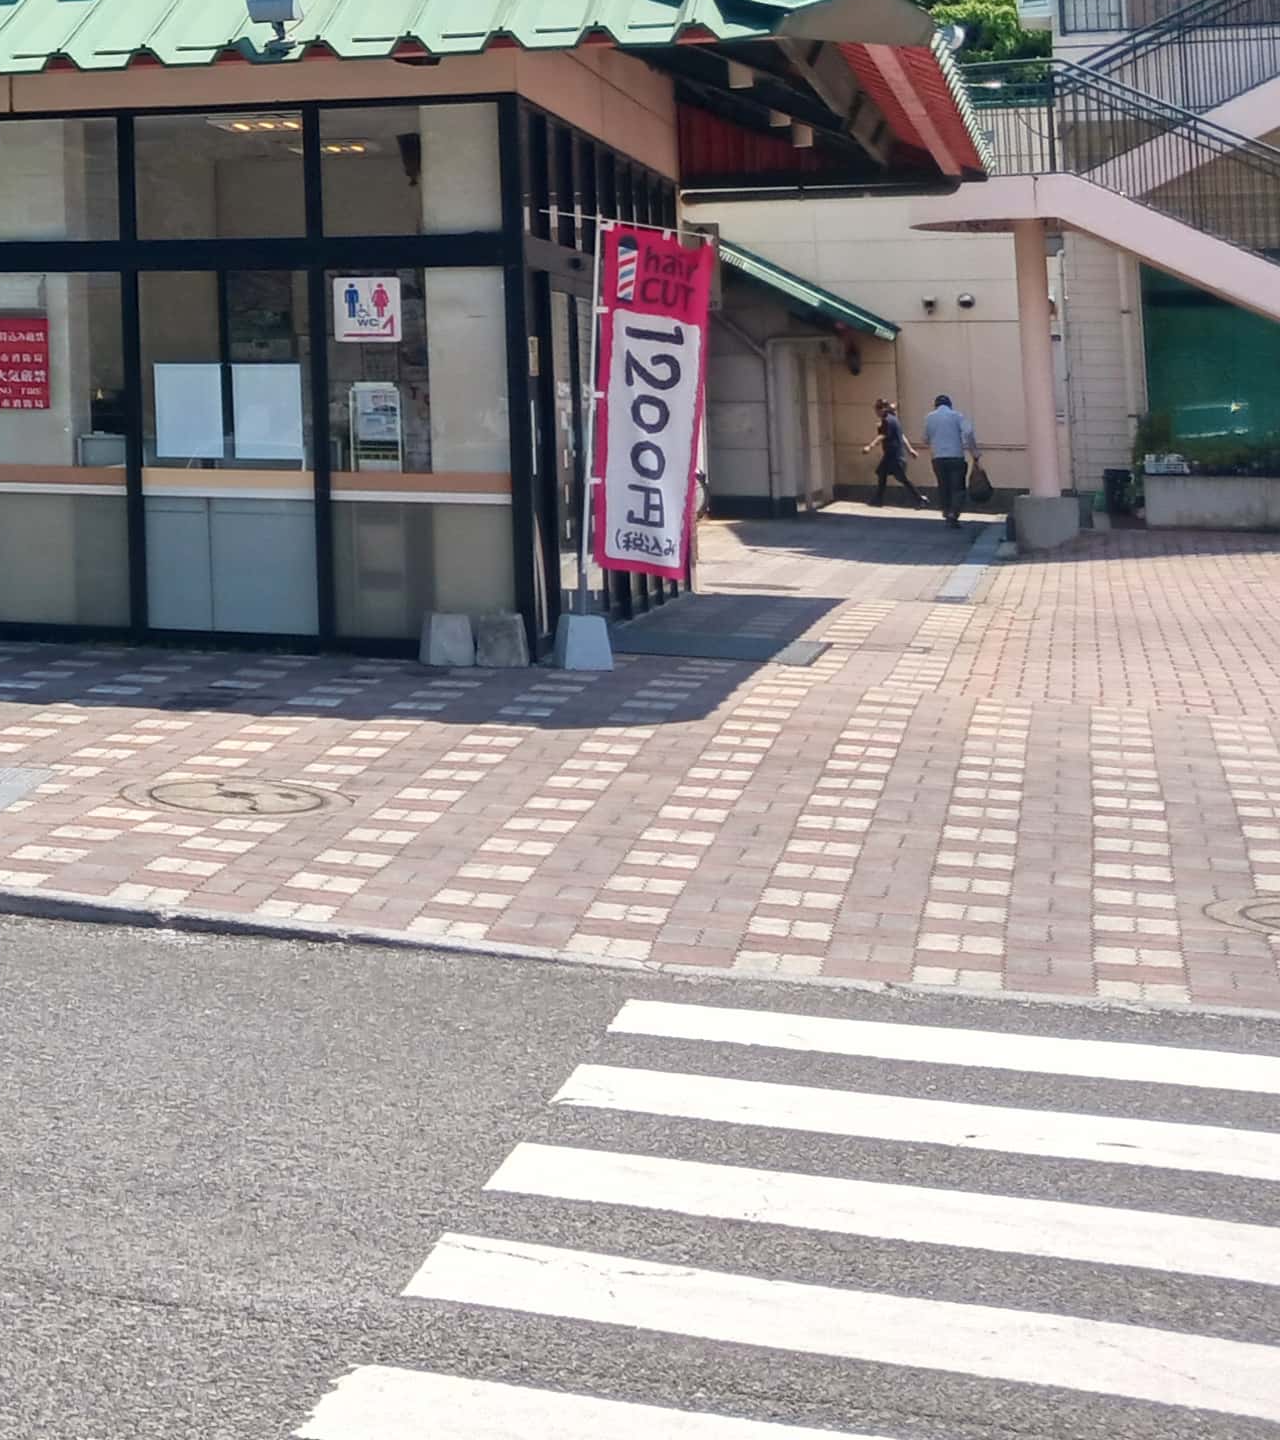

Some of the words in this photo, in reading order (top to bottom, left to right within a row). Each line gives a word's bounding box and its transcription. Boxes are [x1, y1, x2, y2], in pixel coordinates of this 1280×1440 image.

[643, 246, 699, 279] hair
[641, 277, 696, 311] CUT
[357, 318, 380, 327] WC
[624, 325, 685, 529] 1200円
